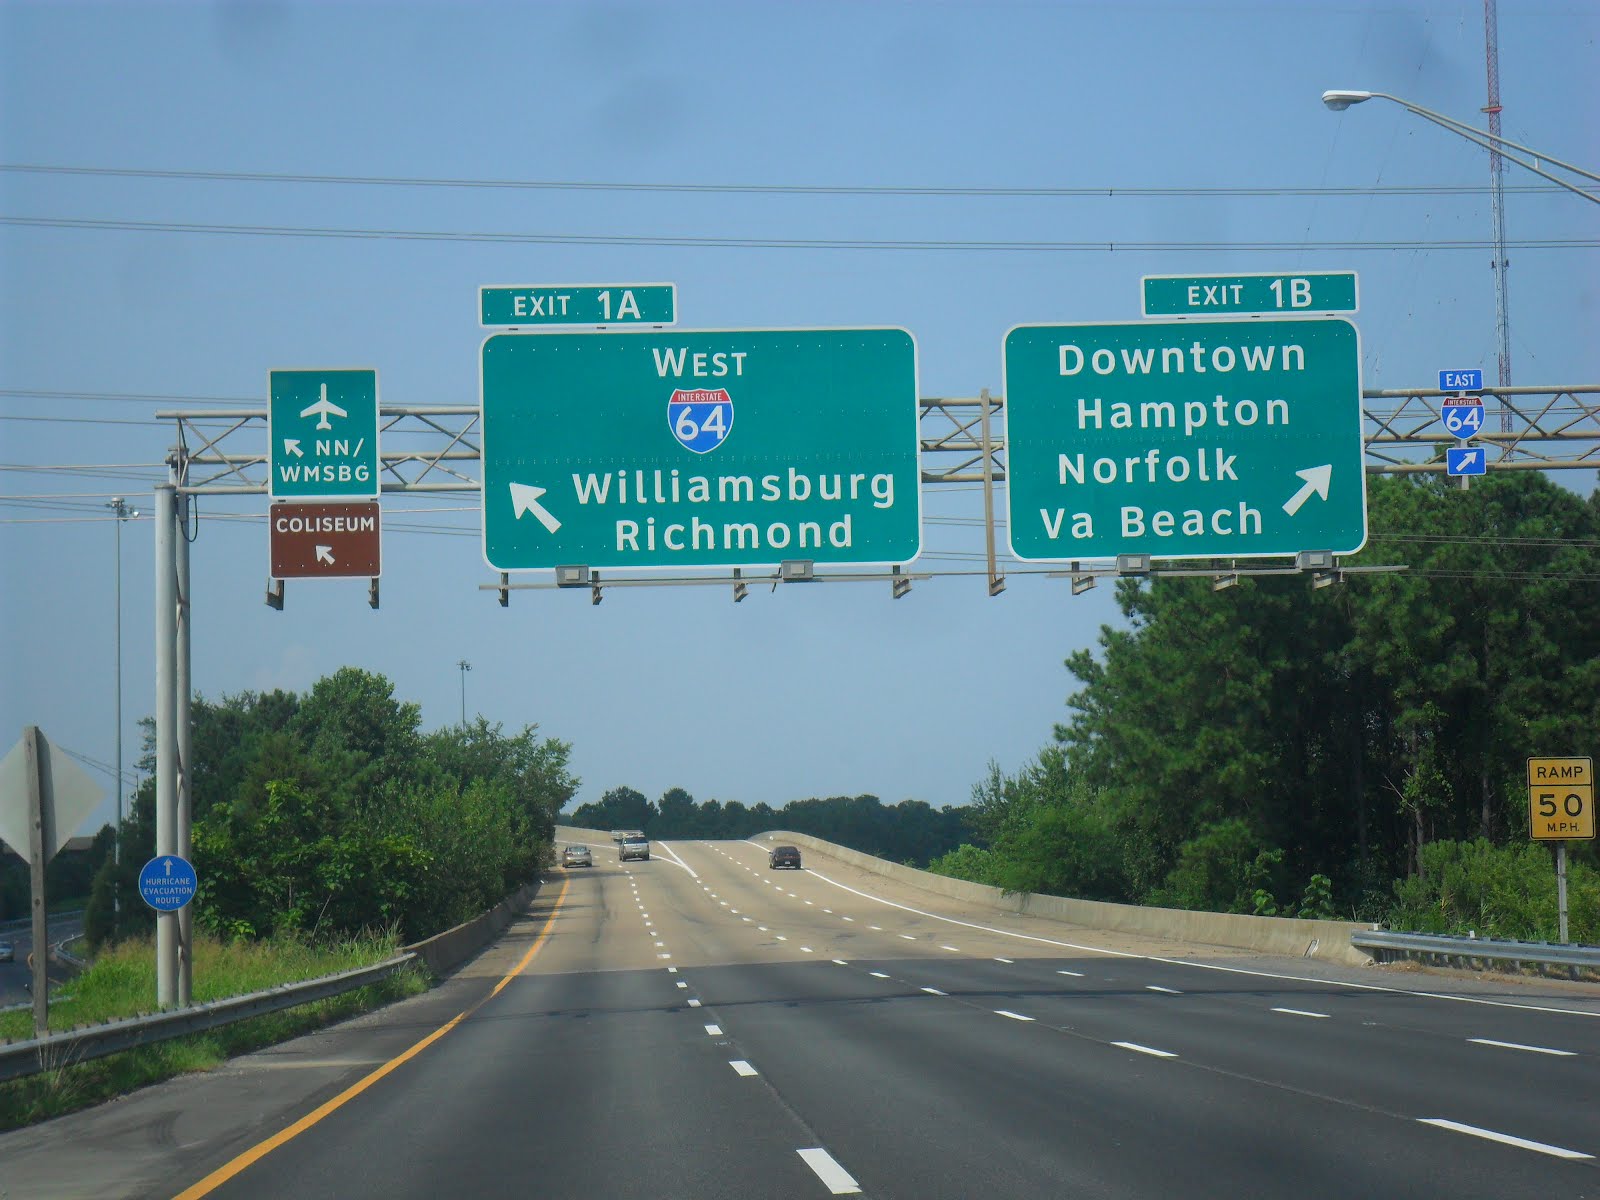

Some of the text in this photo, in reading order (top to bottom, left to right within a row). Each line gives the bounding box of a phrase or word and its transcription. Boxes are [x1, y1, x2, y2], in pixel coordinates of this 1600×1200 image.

[514, 290, 641, 320] EXIT 1A
[1187, 279, 1312, 308] EXIT 1B
[652, 347, 747, 377] WEST
[1059, 341, 1305, 376] Downtown
[1446, 373, 1475, 387] EAST
[677, 391, 722, 402] INTERSTATE
[675, 405, 726, 441] 64
[1078, 395, 1289, 436] Hampton
[1446, 408, 1480, 431] 64
[316, 438, 364, 458] NN/
[280, 465, 370, 482] WMSBG
[1058, 448, 1238, 485] Norfolk
[573, 467, 894, 509] Williamsburg
[276, 517, 374, 533] COLISEUM
[615, 514, 852, 551] Richmond
[1040, 502, 1262, 539] Va Beach
[1537, 766, 1583, 778] RAMP
[1539, 793, 1583, 817] 50
[143, 887, 192, 895] EVACUATION
